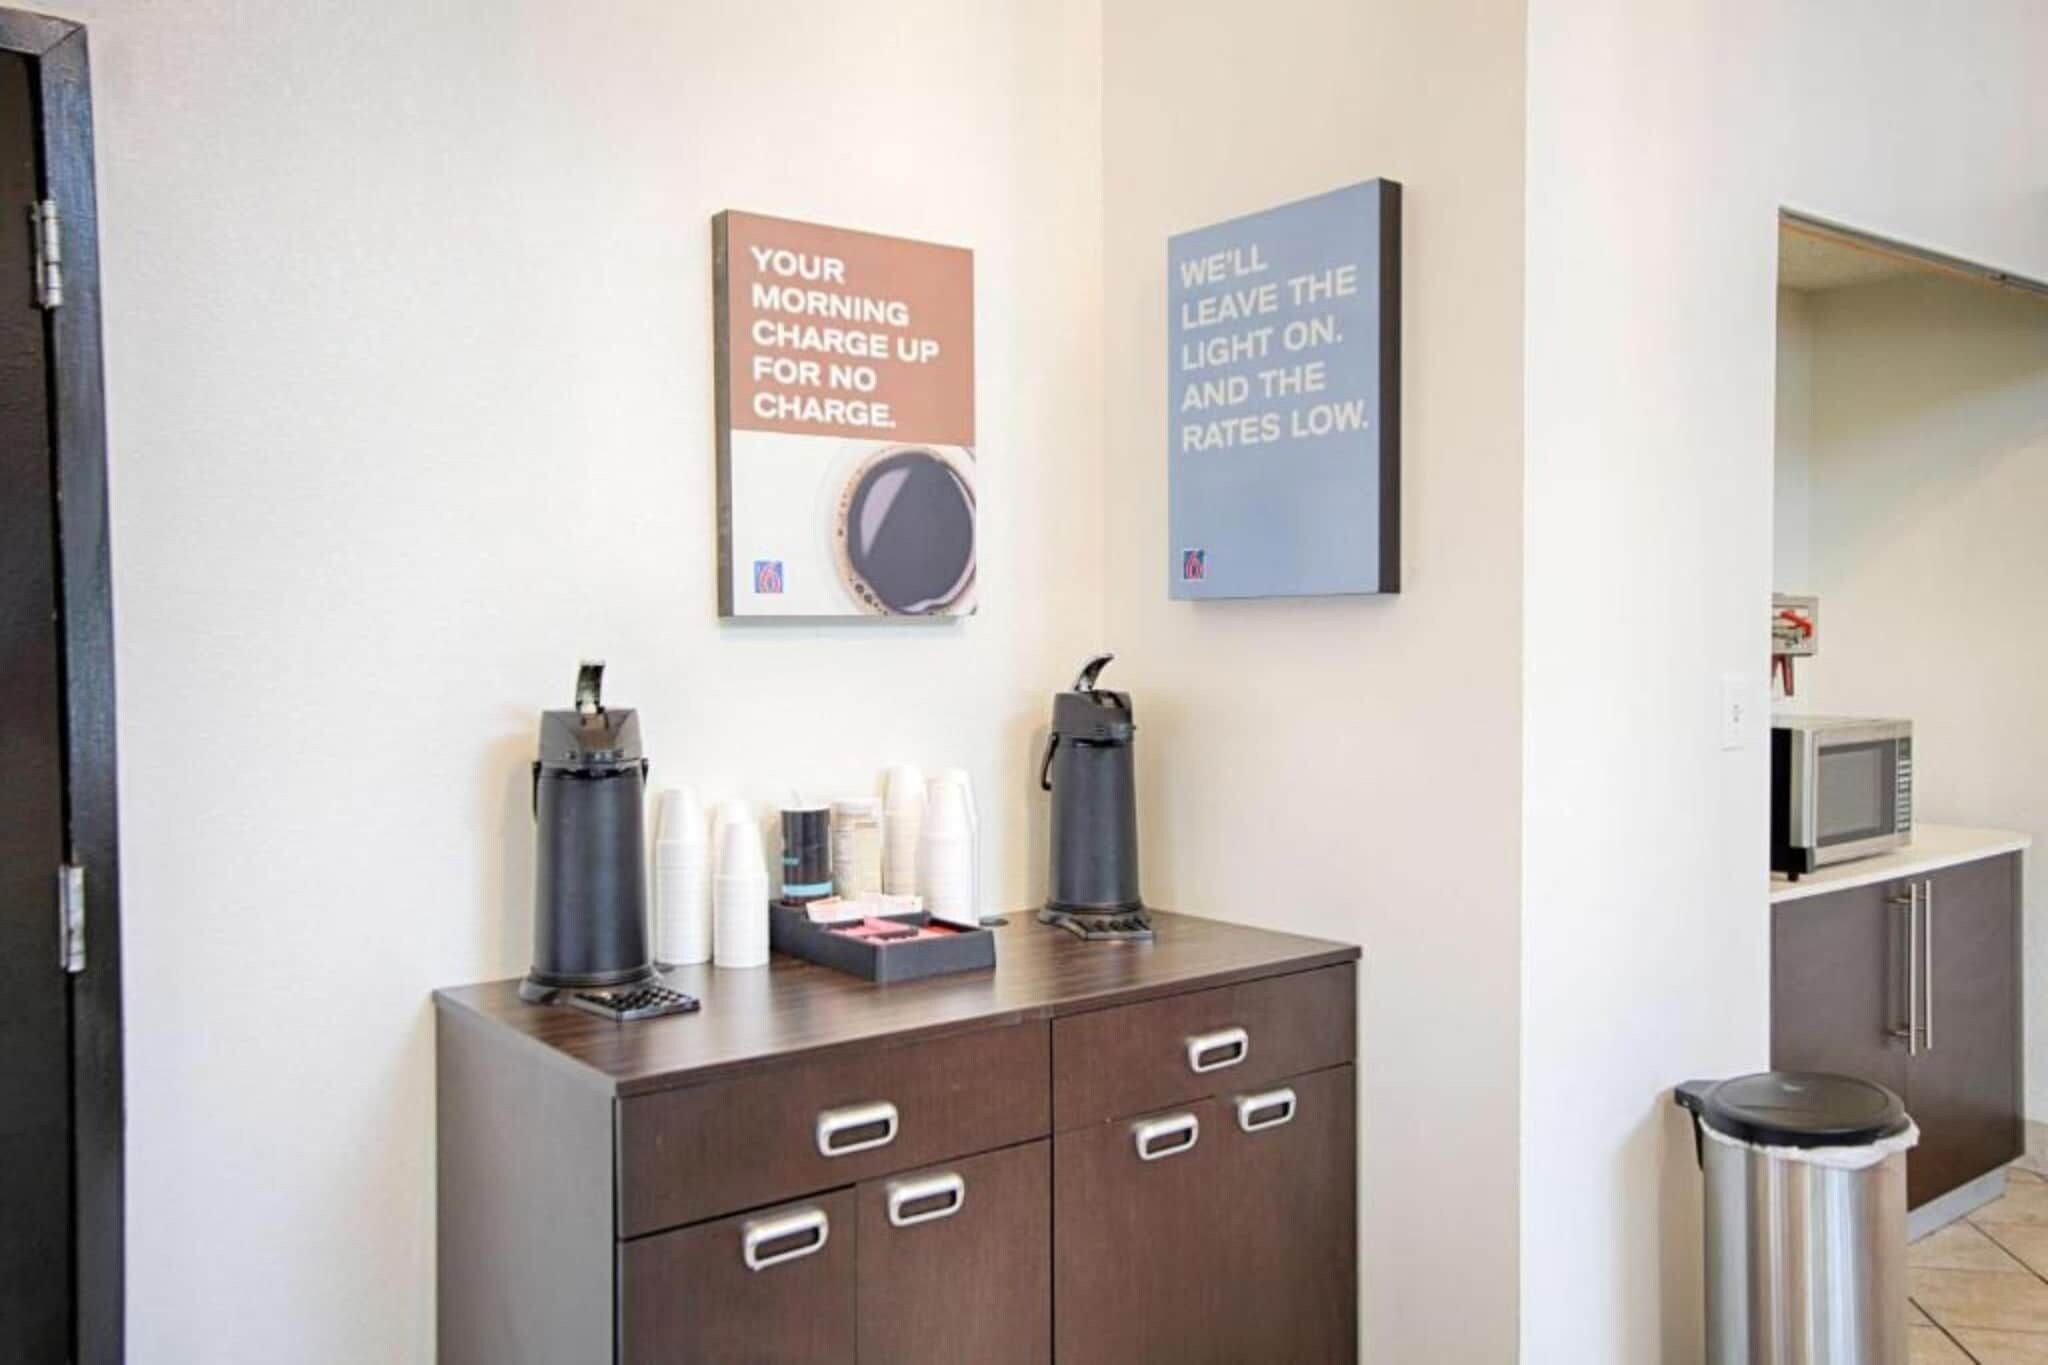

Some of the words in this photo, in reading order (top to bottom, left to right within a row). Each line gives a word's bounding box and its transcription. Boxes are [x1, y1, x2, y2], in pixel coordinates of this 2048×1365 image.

[751, 246, 844, 283] YOUR
[1181, 245, 1267, 288] WE'LL
[753, 284, 908, 326] MORNING
[1182, 284, 1278, 329] LEAVE
[1288, 265, 1357, 305] THE
[753, 320, 888, 359] CHARGE
[897, 338, 938, 363] UP
[1183, 330, 1271, 370] LIGHT
[1284, 316, 1342, 351] ON.
[753, 357, 820, 386] FOR
[831, 365, 876, 391] NO
[1183, 376, 1248, 411] AND
[1259, 363, 1325, 398] THE
[754, 392, 895, 427] CHARGE.
[1183, 413, 1279, 452] RATES
[1292, 401, 1368, 438] LOW.
